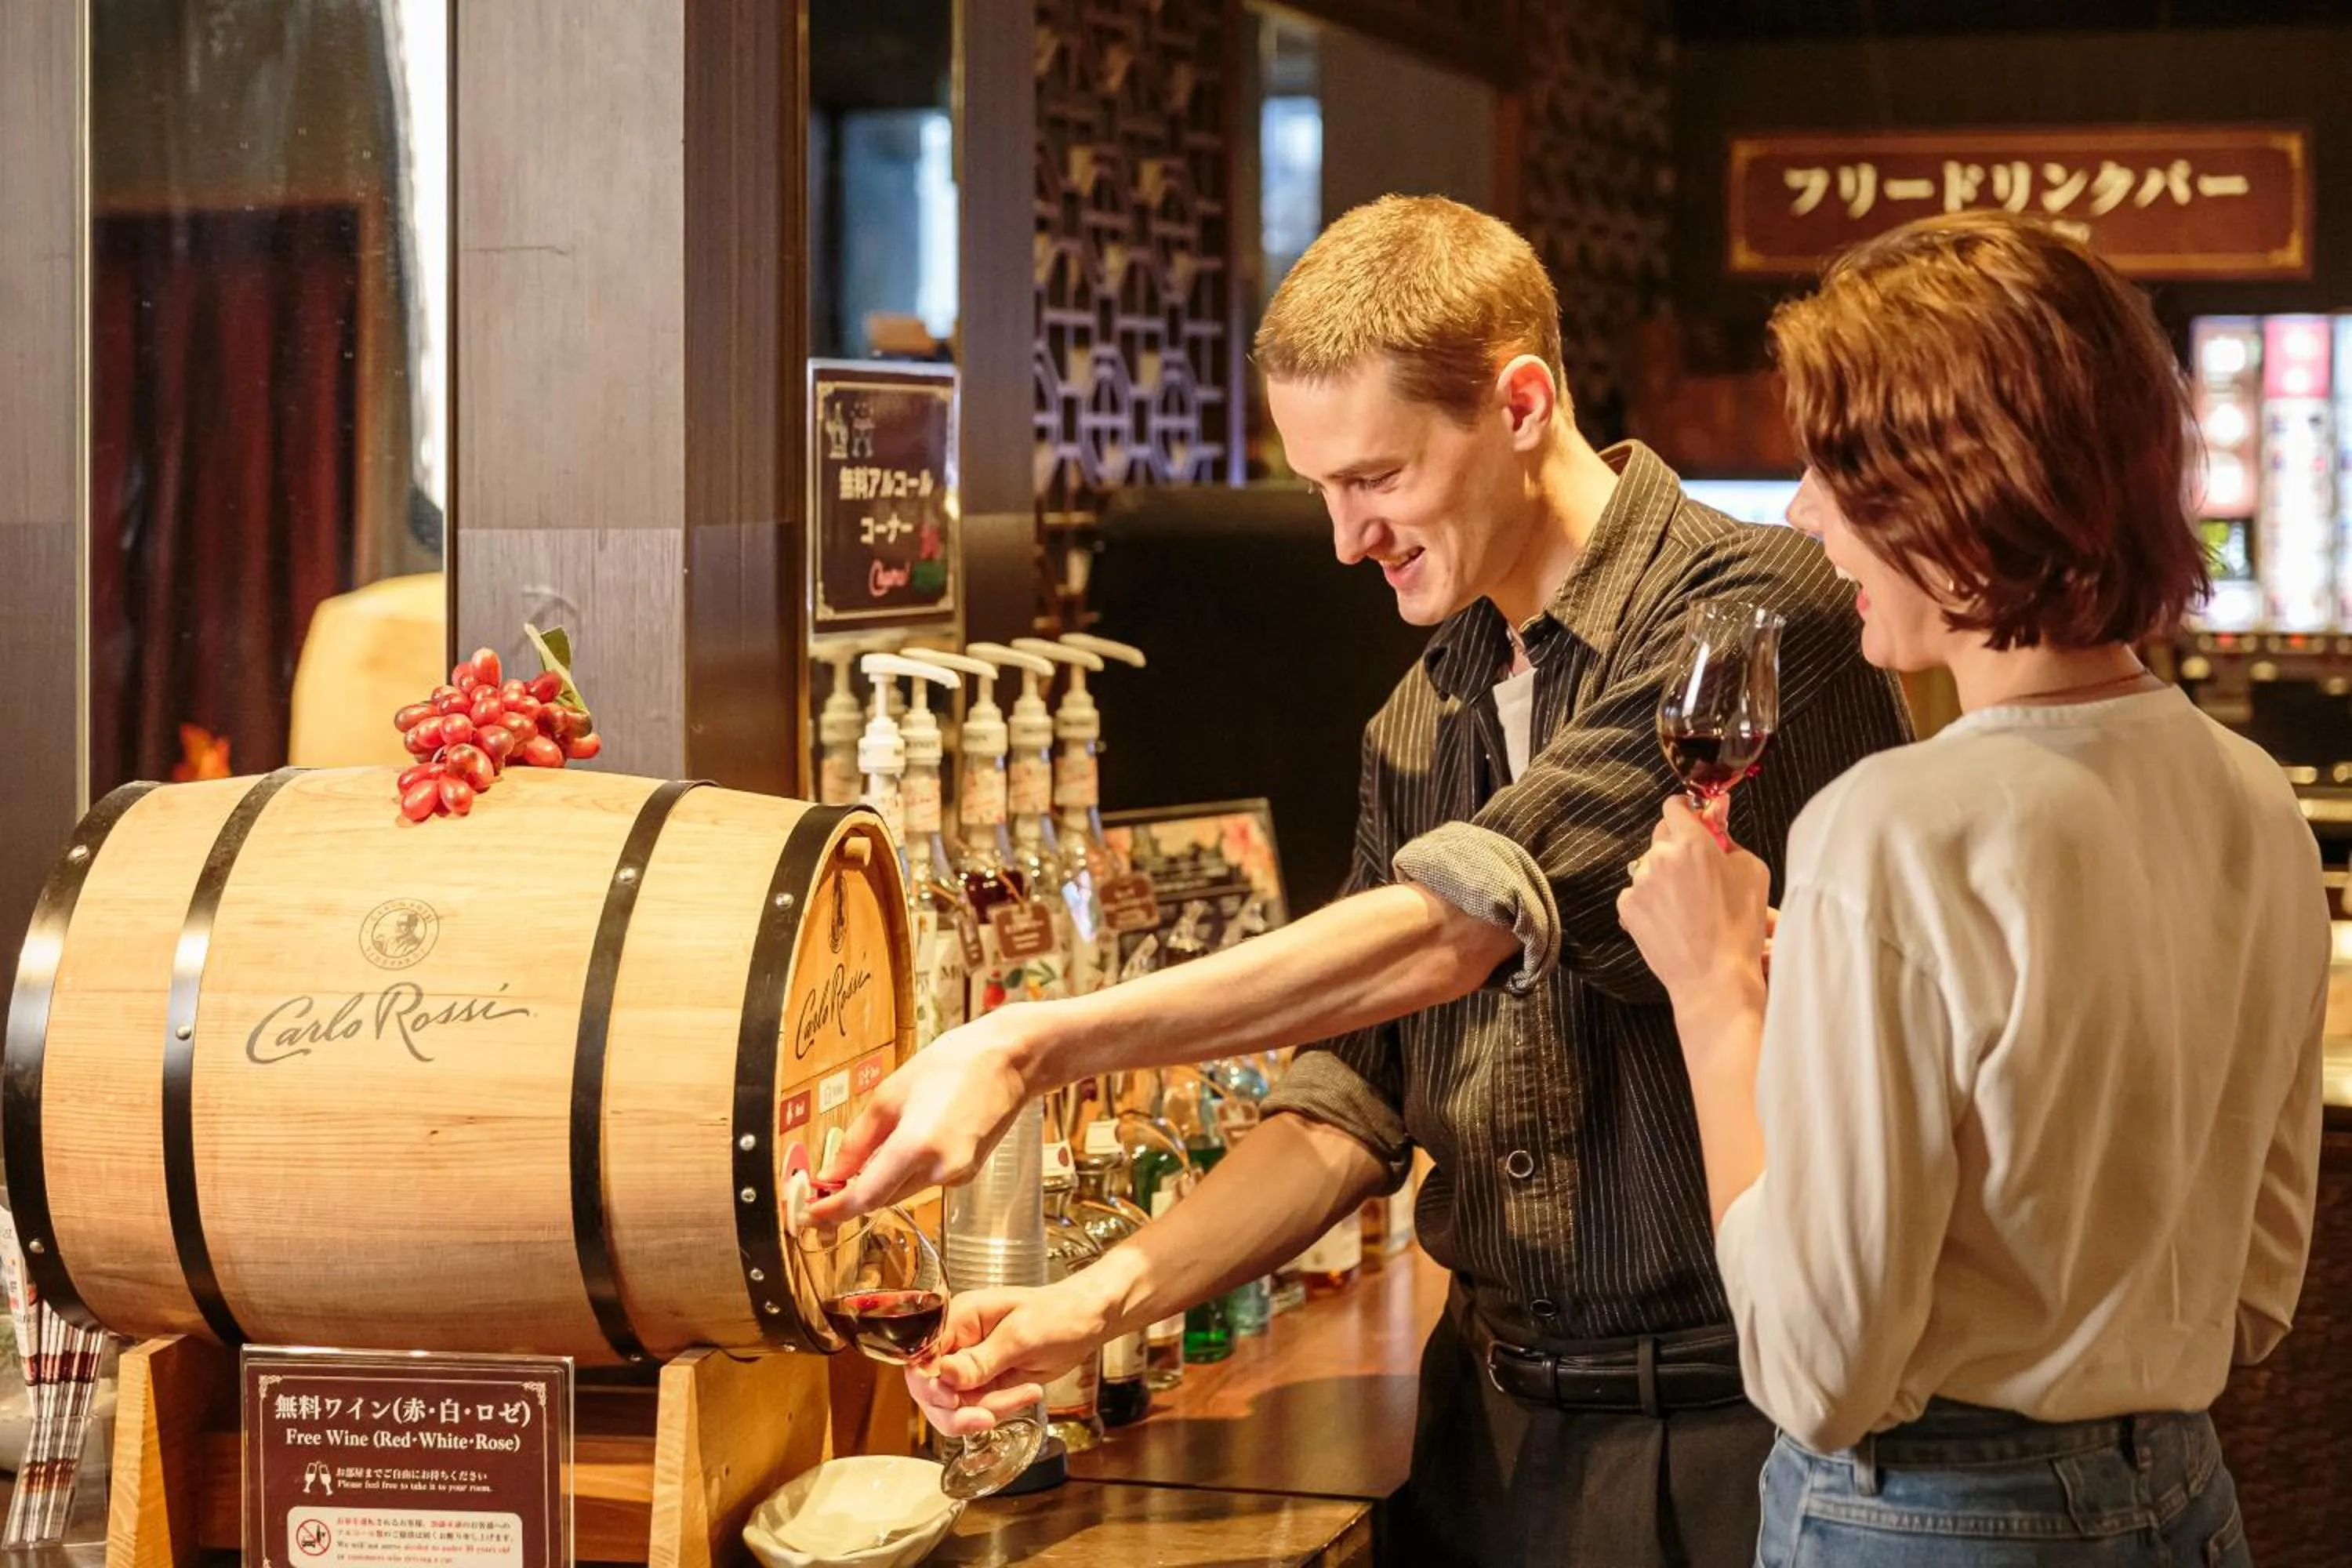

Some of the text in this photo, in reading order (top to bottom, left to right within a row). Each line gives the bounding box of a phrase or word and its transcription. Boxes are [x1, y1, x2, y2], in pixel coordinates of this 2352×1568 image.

[1784, 158, 2249, 220] フリードリンクバー
[840, 466, 934, 499] 無料アルコール
[861, 513, 913, 544] コーナー
[796, 952, 871, 1059] Carlo Rossi
[245, 982, 528, 1064] Carlo Rossi
[285, 1428, 321, 1446] Free
[326, 1429, 368, 1446] Wine
[338, 1479, 362, 1488] Please
[365, 1480, 379, 1489] feel
[410, 1482, 427, 1490] take
